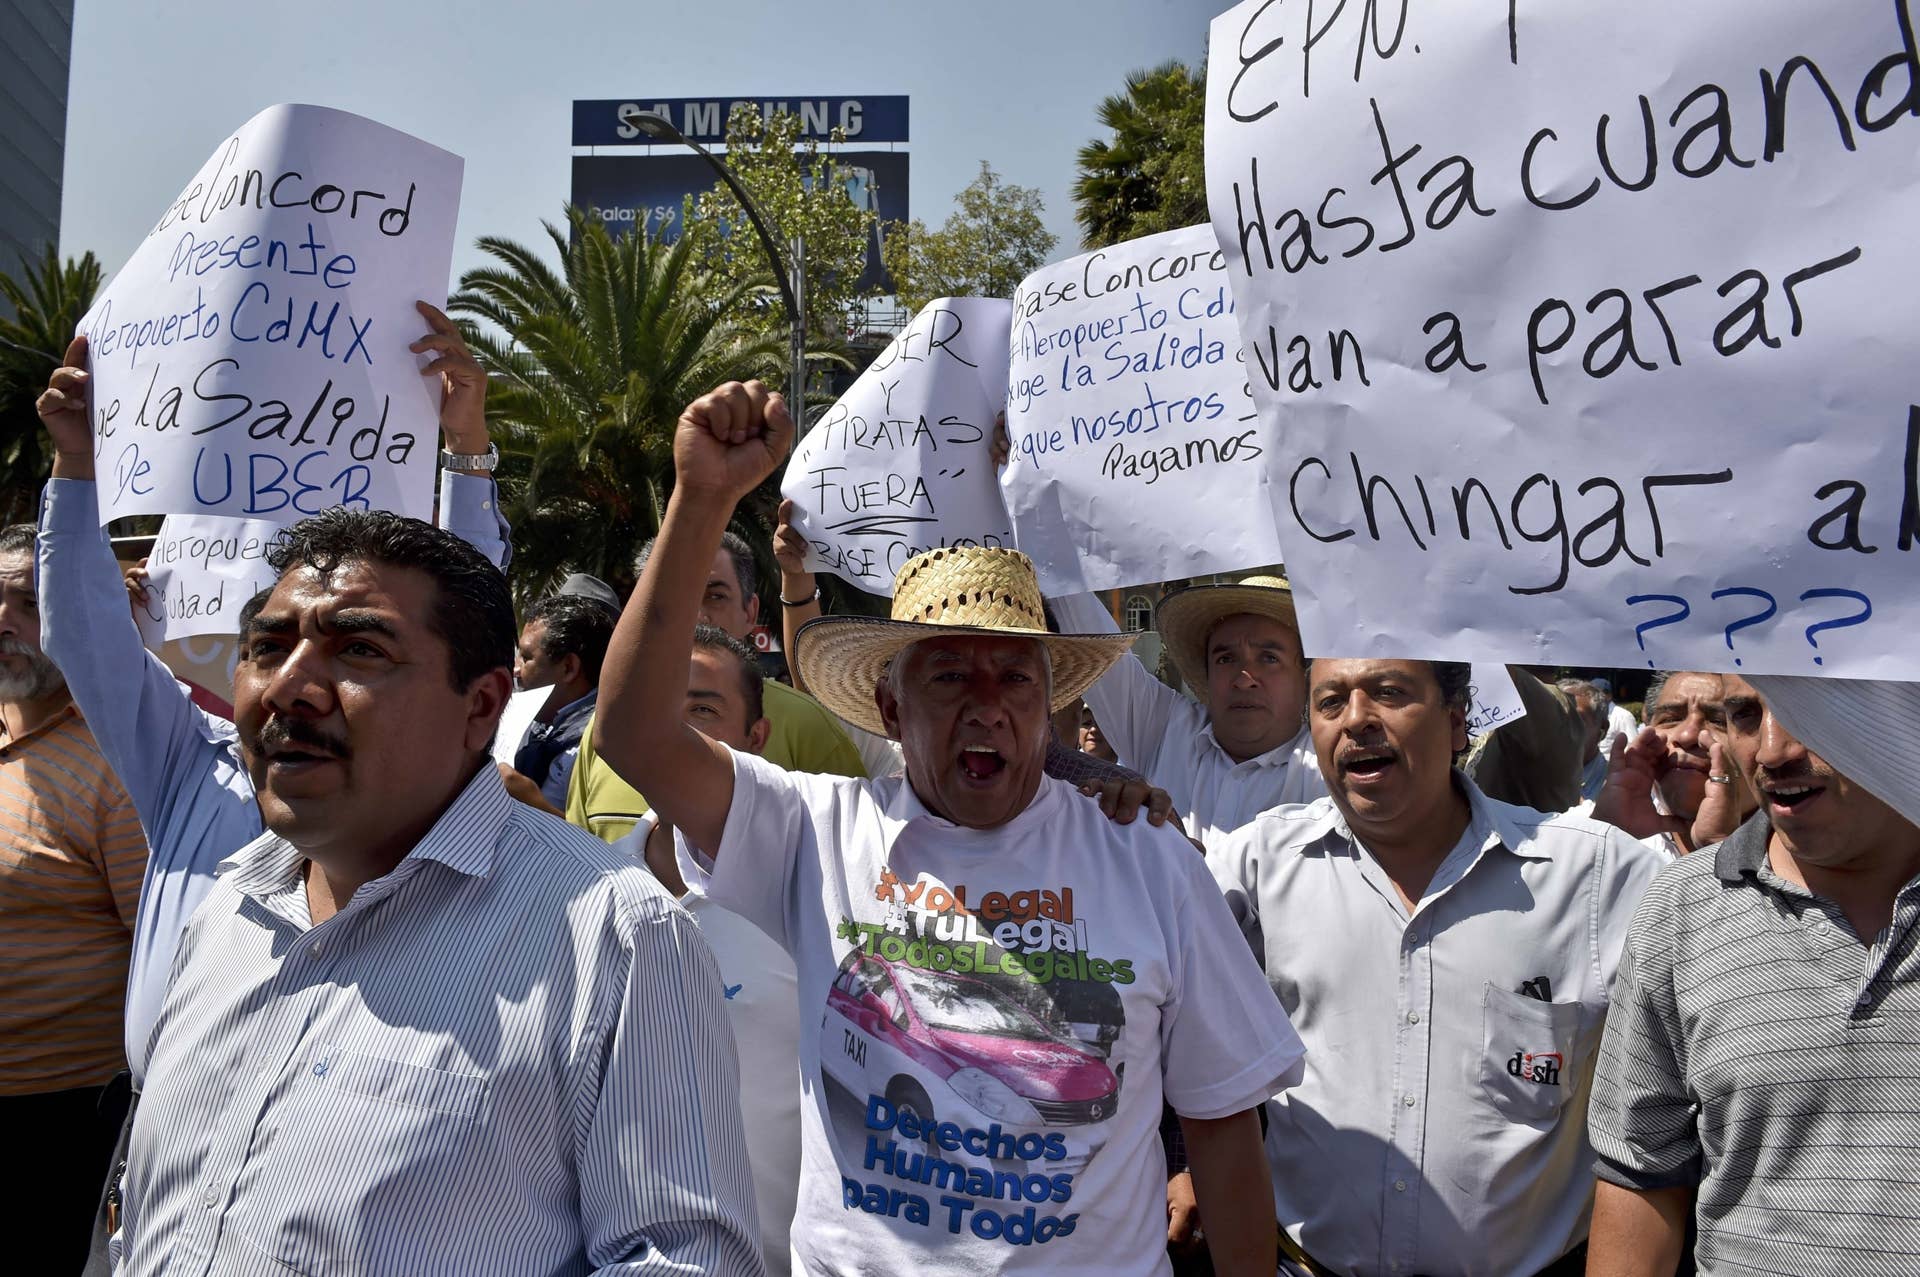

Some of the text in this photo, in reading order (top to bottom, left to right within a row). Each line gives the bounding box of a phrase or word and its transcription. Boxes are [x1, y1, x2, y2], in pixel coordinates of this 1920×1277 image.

[1233, 97, 1496, 277] Hasta
[168, 222, 357, 288] Presente
[1423, 311, 1487, 372] a
[1527, 245, 1861, 404] parar
[1060, 354, 1096, 391] la
[1104, 328, 1225, 381] Salida
[134, 363, 183, 432] la
[191, 358, 416, 465] Salida
[824, 403, 984, 452] PIRATAS
[880, 380, 900, 416] Y
[1071, 382, 1225, 443] nosotros
[113, 442, 371, 515] De UBER
[1101, 430, 1264, 484] Pagamos
[1289, 451, 1733, 595] Chingar
[809, 540, 882, 579] BASE
[836, 916, 1136, 985] #TodosLegales
[844, 1028, 867, 1069] TAXI
[1507, 1051, 1563, 1086] dish
[865, 1093, 1068, 1161] Derechos
[863, 1134, 1074, 1203] Humanos
[841, 1175, 1081, 1246] para Todos
